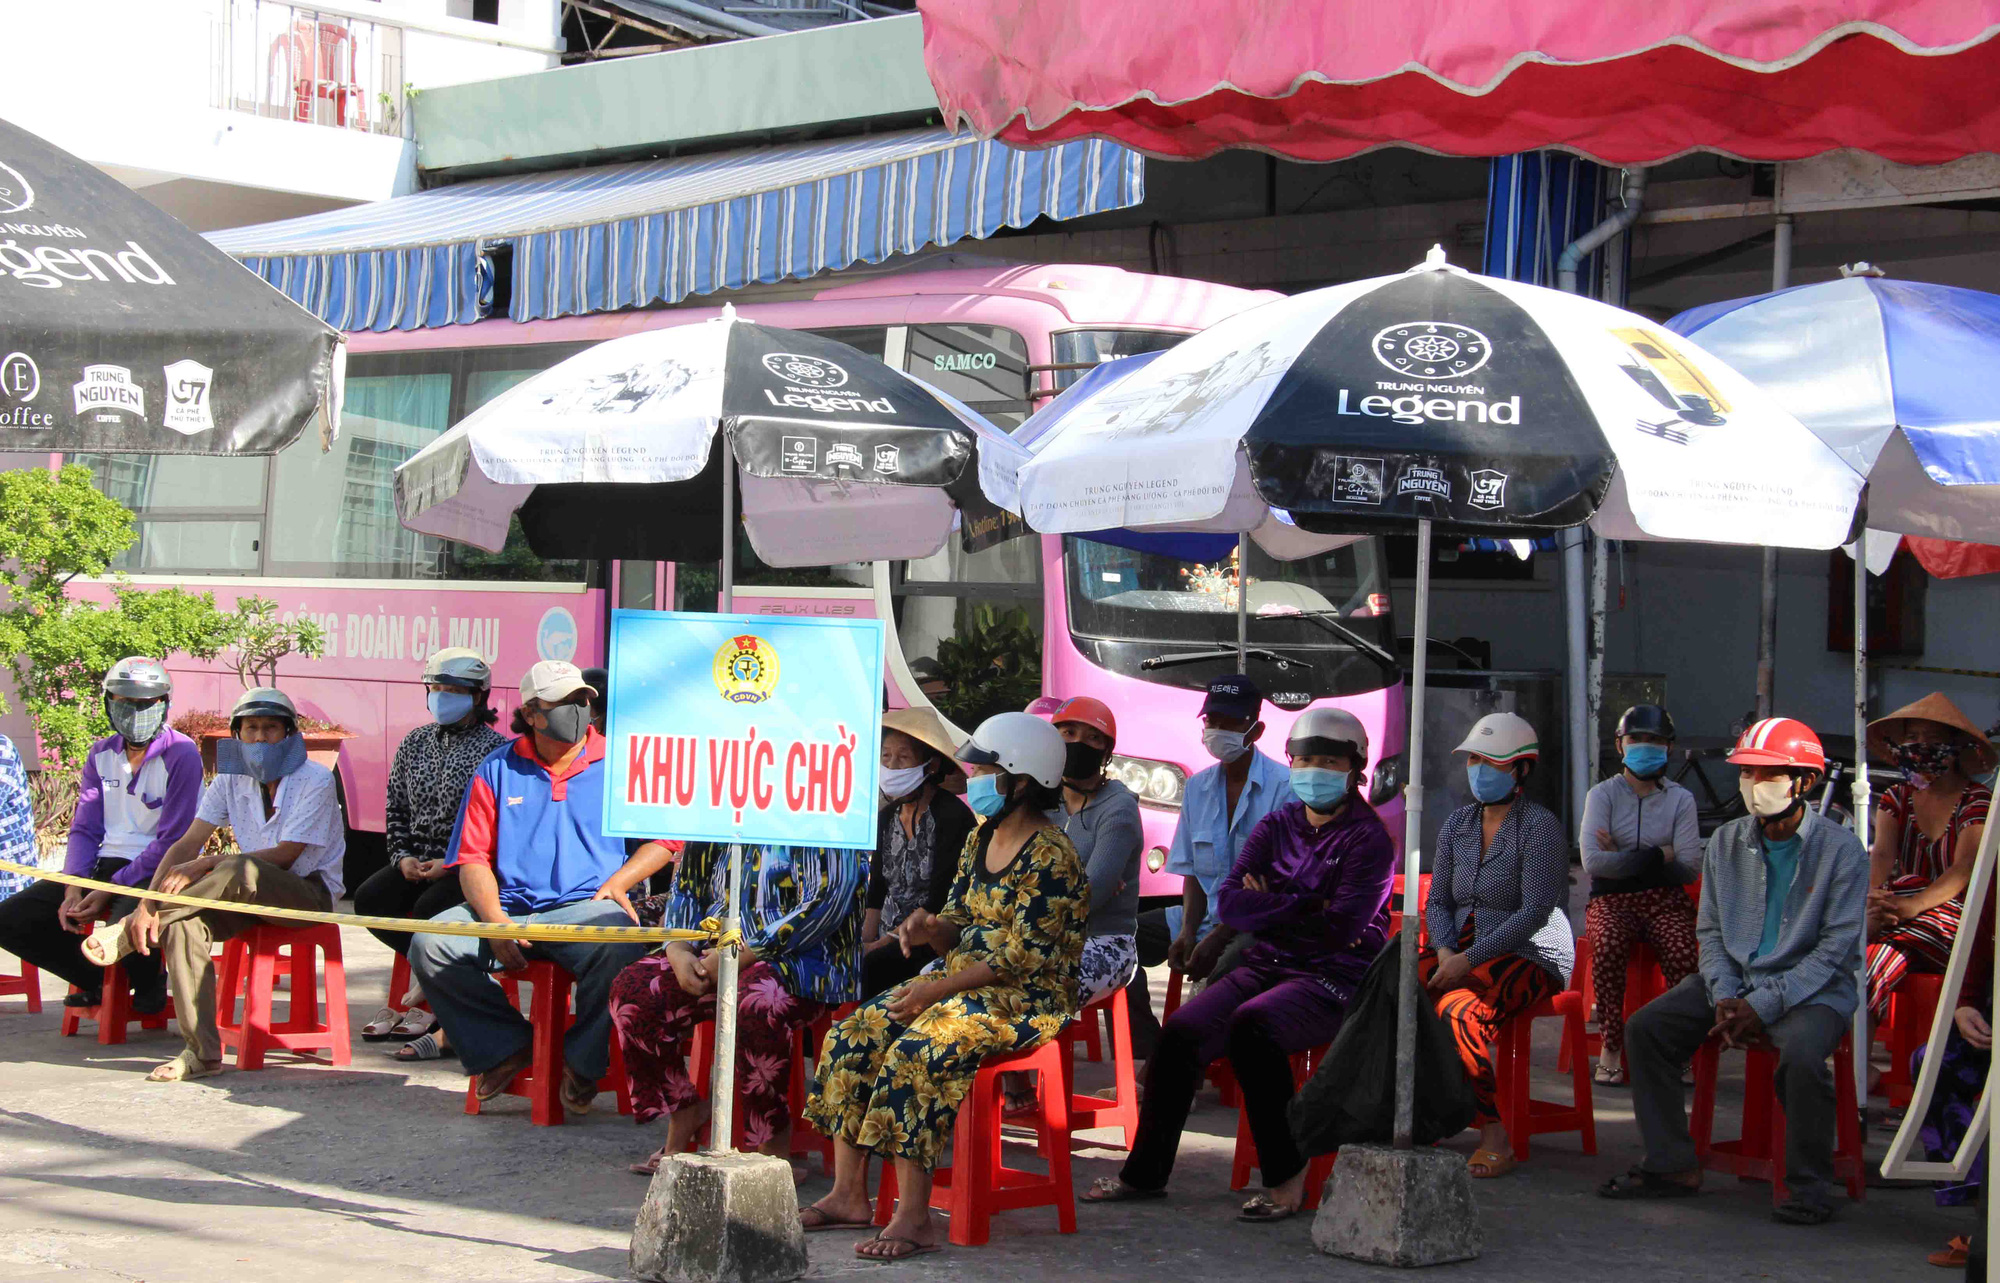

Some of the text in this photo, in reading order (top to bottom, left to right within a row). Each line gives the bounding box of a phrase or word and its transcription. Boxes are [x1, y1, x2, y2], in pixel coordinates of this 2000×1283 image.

[4, 222, 88, 239] NGUYÊN
[0, 239, 177, 288] gend
[934, 352, 997, 371] SAMCO
[90, 371, 124, 383] TRUNG
[171, 379, 206, 405] G7
[784, 386, 820, 395] TRUNG
[1375, 381, 1485, 395] TRUNG NGUYÊN
[763, 389, 898, 413] Legend
[1337, 389, 1521, 425] Legend
[611, 446, 647, 455] LEGEND
[877, 450, 897, 463] G7
[1411, 470, 1438, 479] TRUNG
[1085, 483, 1111, 496] TRUNG
[1146, 478, 1178, 489] LEGEND
[1474, 478, 1502, 494] G7
[759, 605, 809, 614] FELIX
[345, 605, 405, 660] ĐOÀN
[412, 606, 440, 661] CÀ
[450, 617, 500, 665] MAU
[627, 725, 857, 823] KHU VỰC CHỜ
